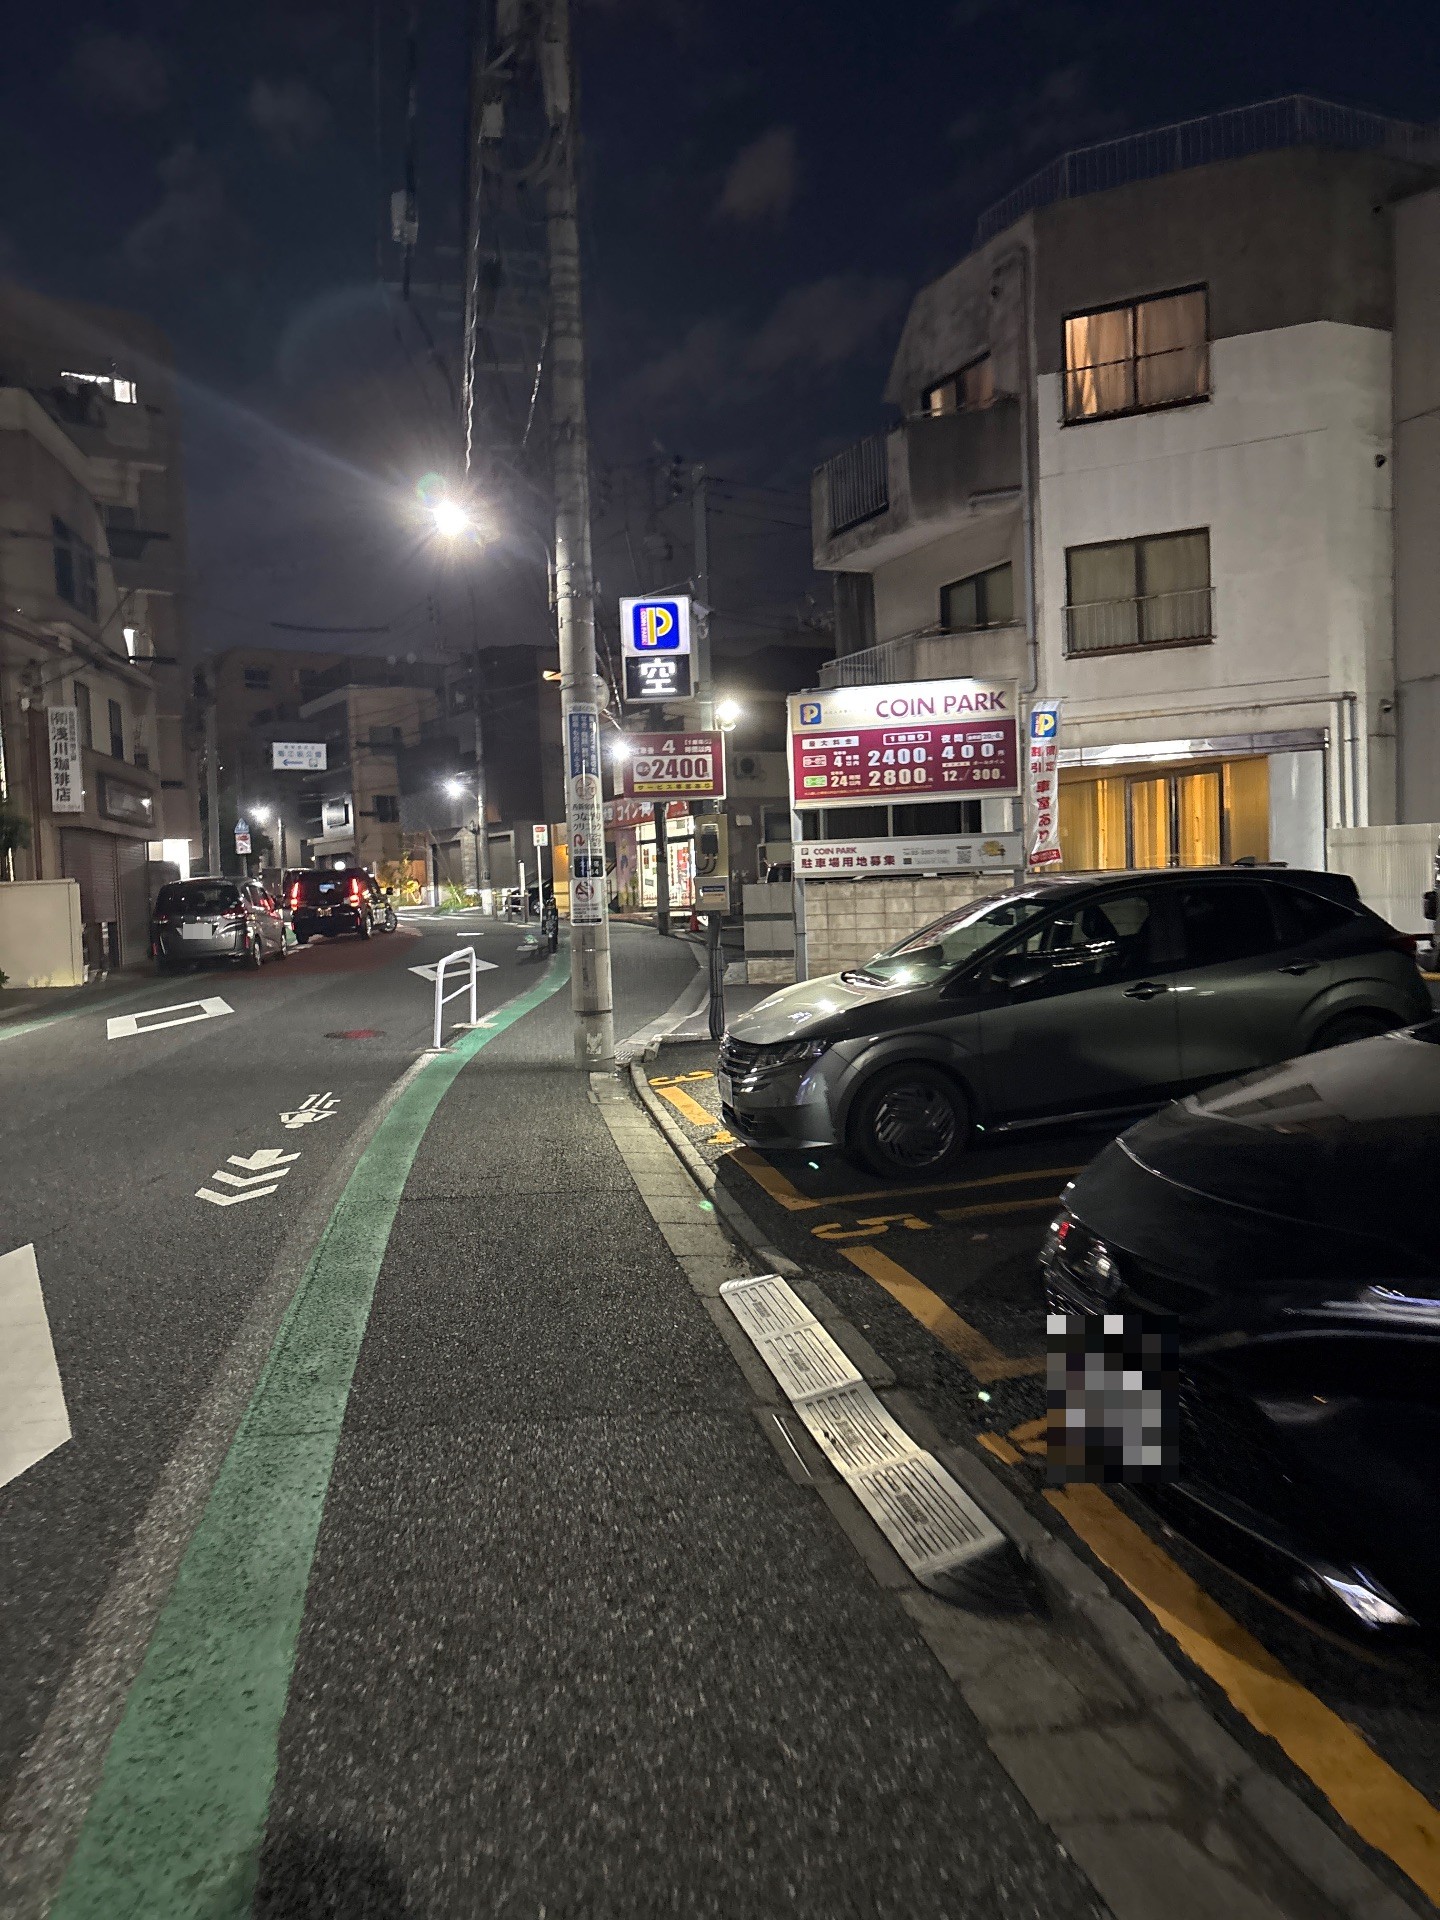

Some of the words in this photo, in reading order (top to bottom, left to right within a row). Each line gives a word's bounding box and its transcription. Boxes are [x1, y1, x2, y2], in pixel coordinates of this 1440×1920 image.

[640, 658, 677, 694] 空
[876, 697, 934, 718] COIN
[944, 691, 1006, 713] PARK
[662, 739, 676, 754] 4
[808, 738, 853, 748] 最大料金
[651, 757, 708, 779] 2400
[833, 756, 843, 768] 4
[867, 747, 927, 767] 2400
[831, 775, 849, 788] 24
[868, 767, 927, 787] 2800
[801, 855, 896, 869] 駐車場用地募集
